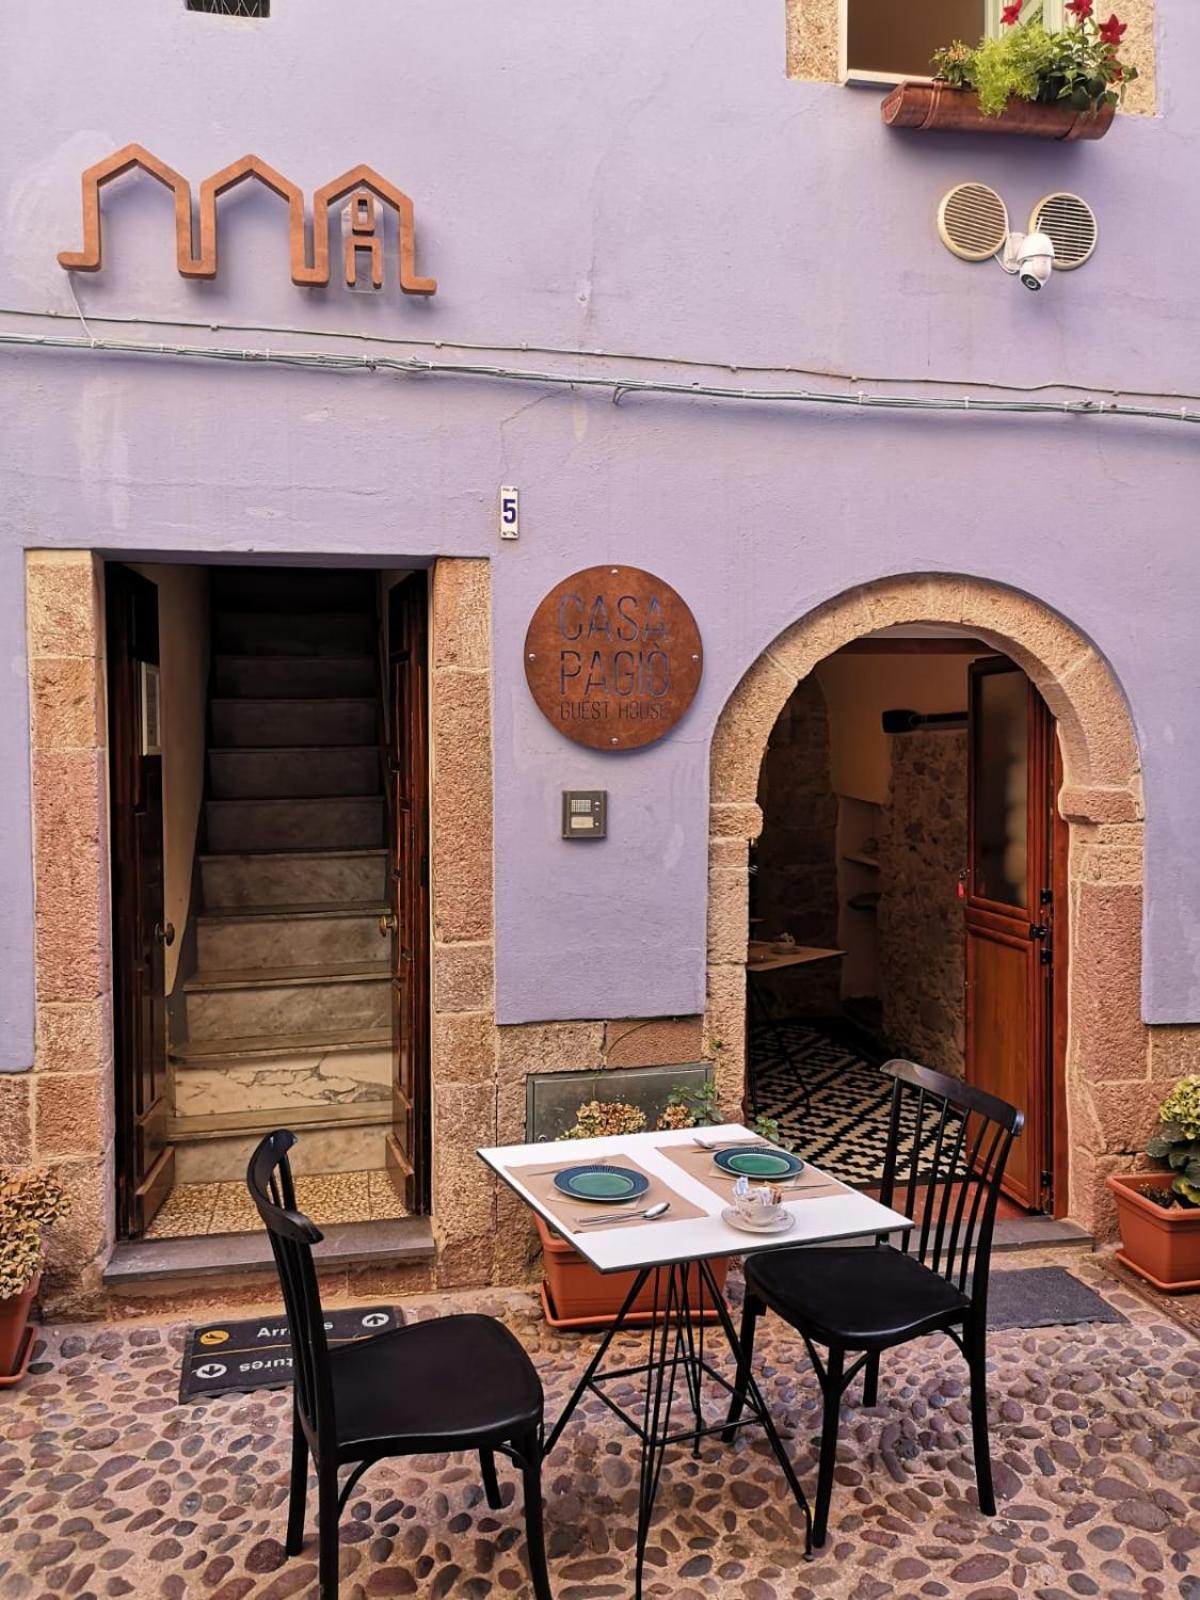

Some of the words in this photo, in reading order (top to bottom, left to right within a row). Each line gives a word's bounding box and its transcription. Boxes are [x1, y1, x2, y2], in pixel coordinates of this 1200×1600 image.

[503, 499, 516, 524] 5
[559, 595, 669, 641] CASA
[560, 642, 670, 697] PAGIÒ
[560, 701, 610, 720] GUEST
[618, 701, 671, 720] HOUSE
